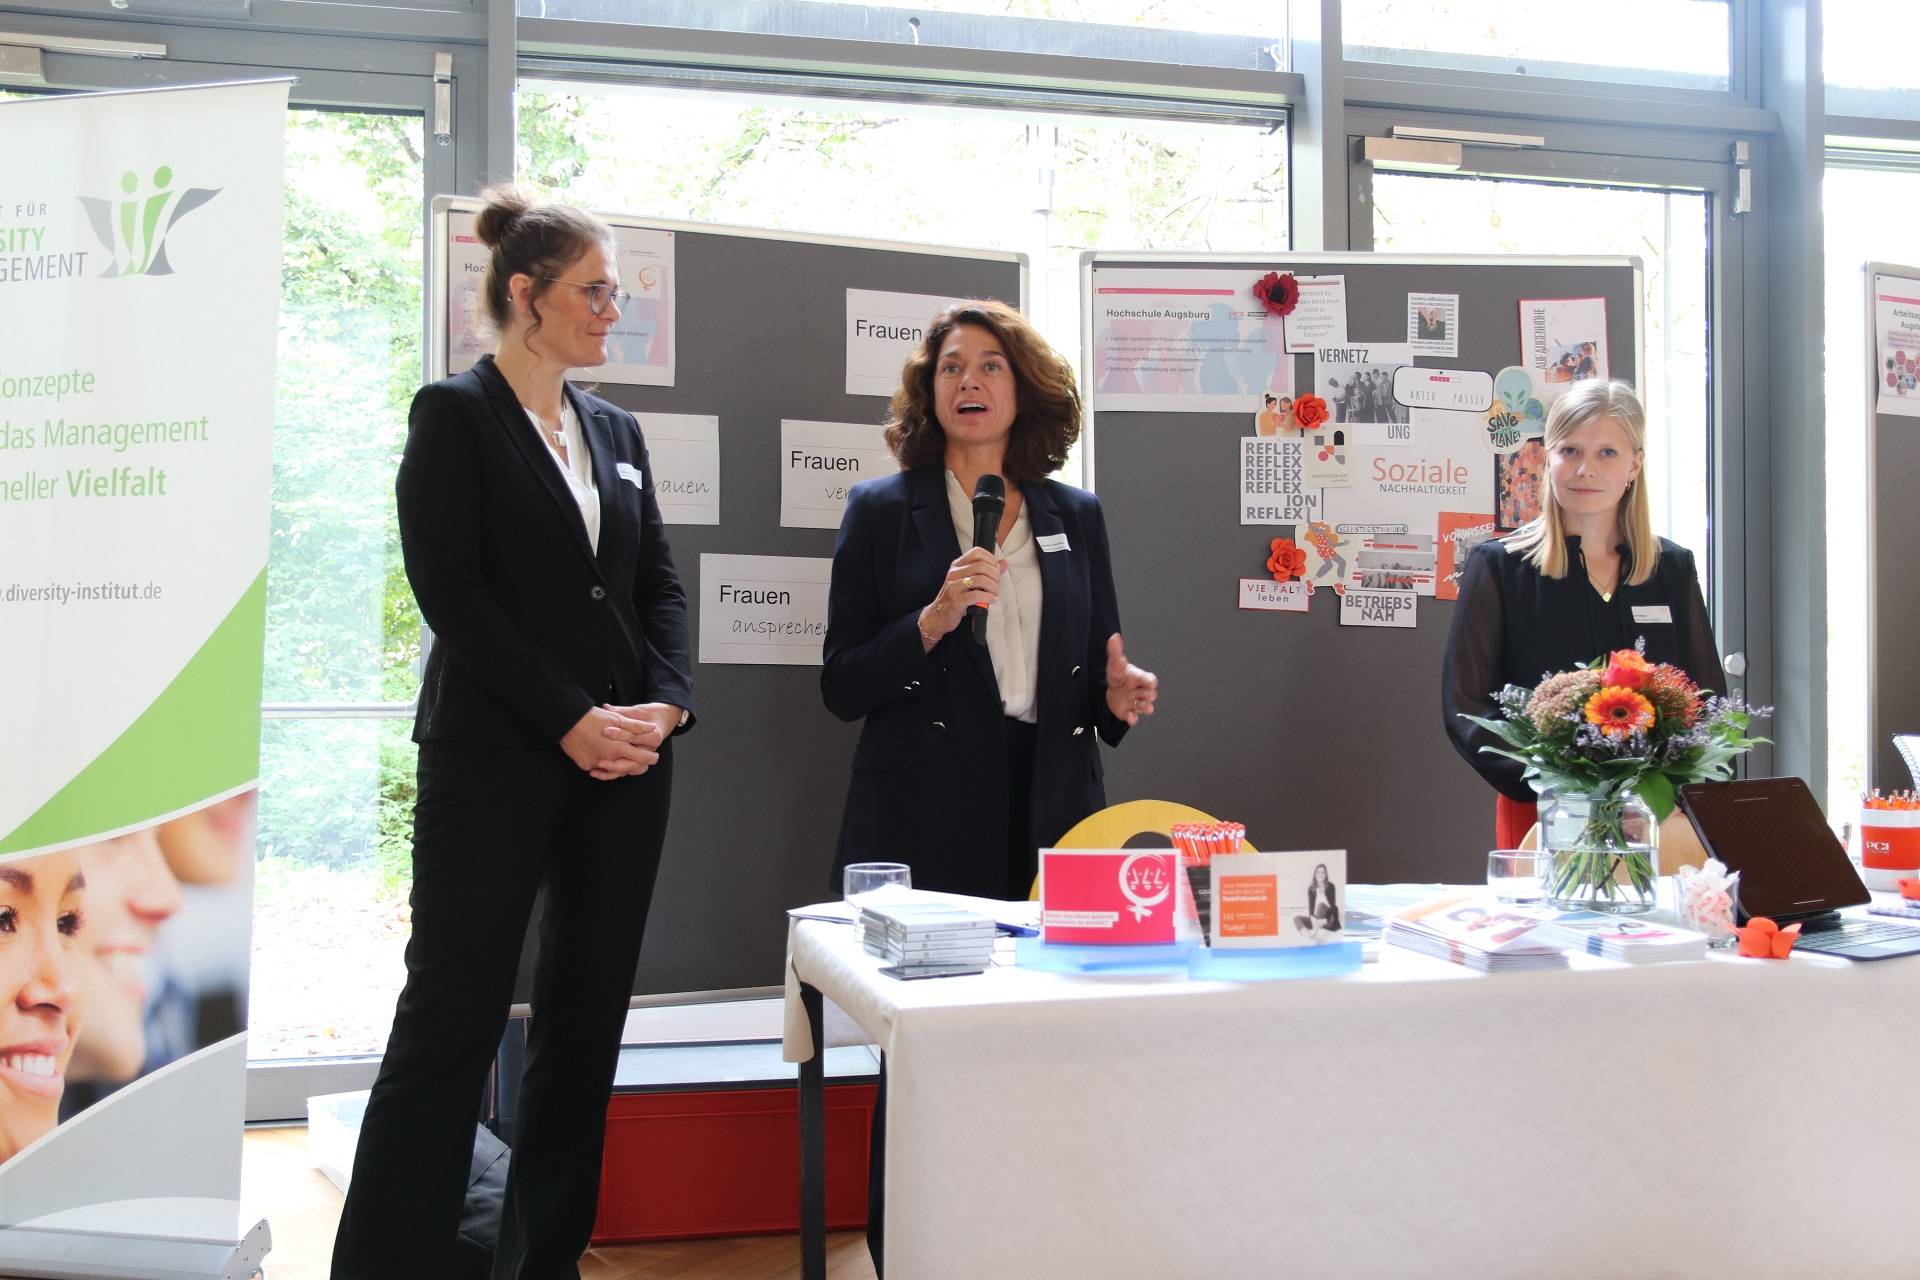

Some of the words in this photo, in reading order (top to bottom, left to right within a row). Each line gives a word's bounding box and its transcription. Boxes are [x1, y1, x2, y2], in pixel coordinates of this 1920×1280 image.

[16, 200, 48, 217] FÜR
[1106, 309, 1162, 318] Hochschule
[1164, 309, 1210, 320] Augsburg
[856, 319, 921, 341] Frauen
[1319, 348, 1369, 364] VERNETZ
[0, 369, 95, 402] onzepte
[1453, 393, 1486, 405] PASSIV
[43, 416, 209, 453] Management
[1387, 425, 1411, 440] UNG
[1245, 442, 1303, 456] REFLEX
[790, 451, 860, 472] Frauen
[1245, 455, 1303, 469] REFLEX
[1245, 468, 1303, 482] REFLEX
[1372, 457, 1469, 485] Soziale
[66, 467, 168, 498] Vielfalt
[1245, 481, 1303, 495] REFLEX
[1379, 483, 1468, 496] NACHHALTIGKEIT
[1286, 494, 1318, 508] ION
[1246, 506, 1304, 520] REFLEX
[719, 585, 791, 605] Frauen
[1258, 593, 1289, 603] leben
[1345, 595, 1413, 610] BETRIEBS
[1361, 608, 1395, 622] NAH
